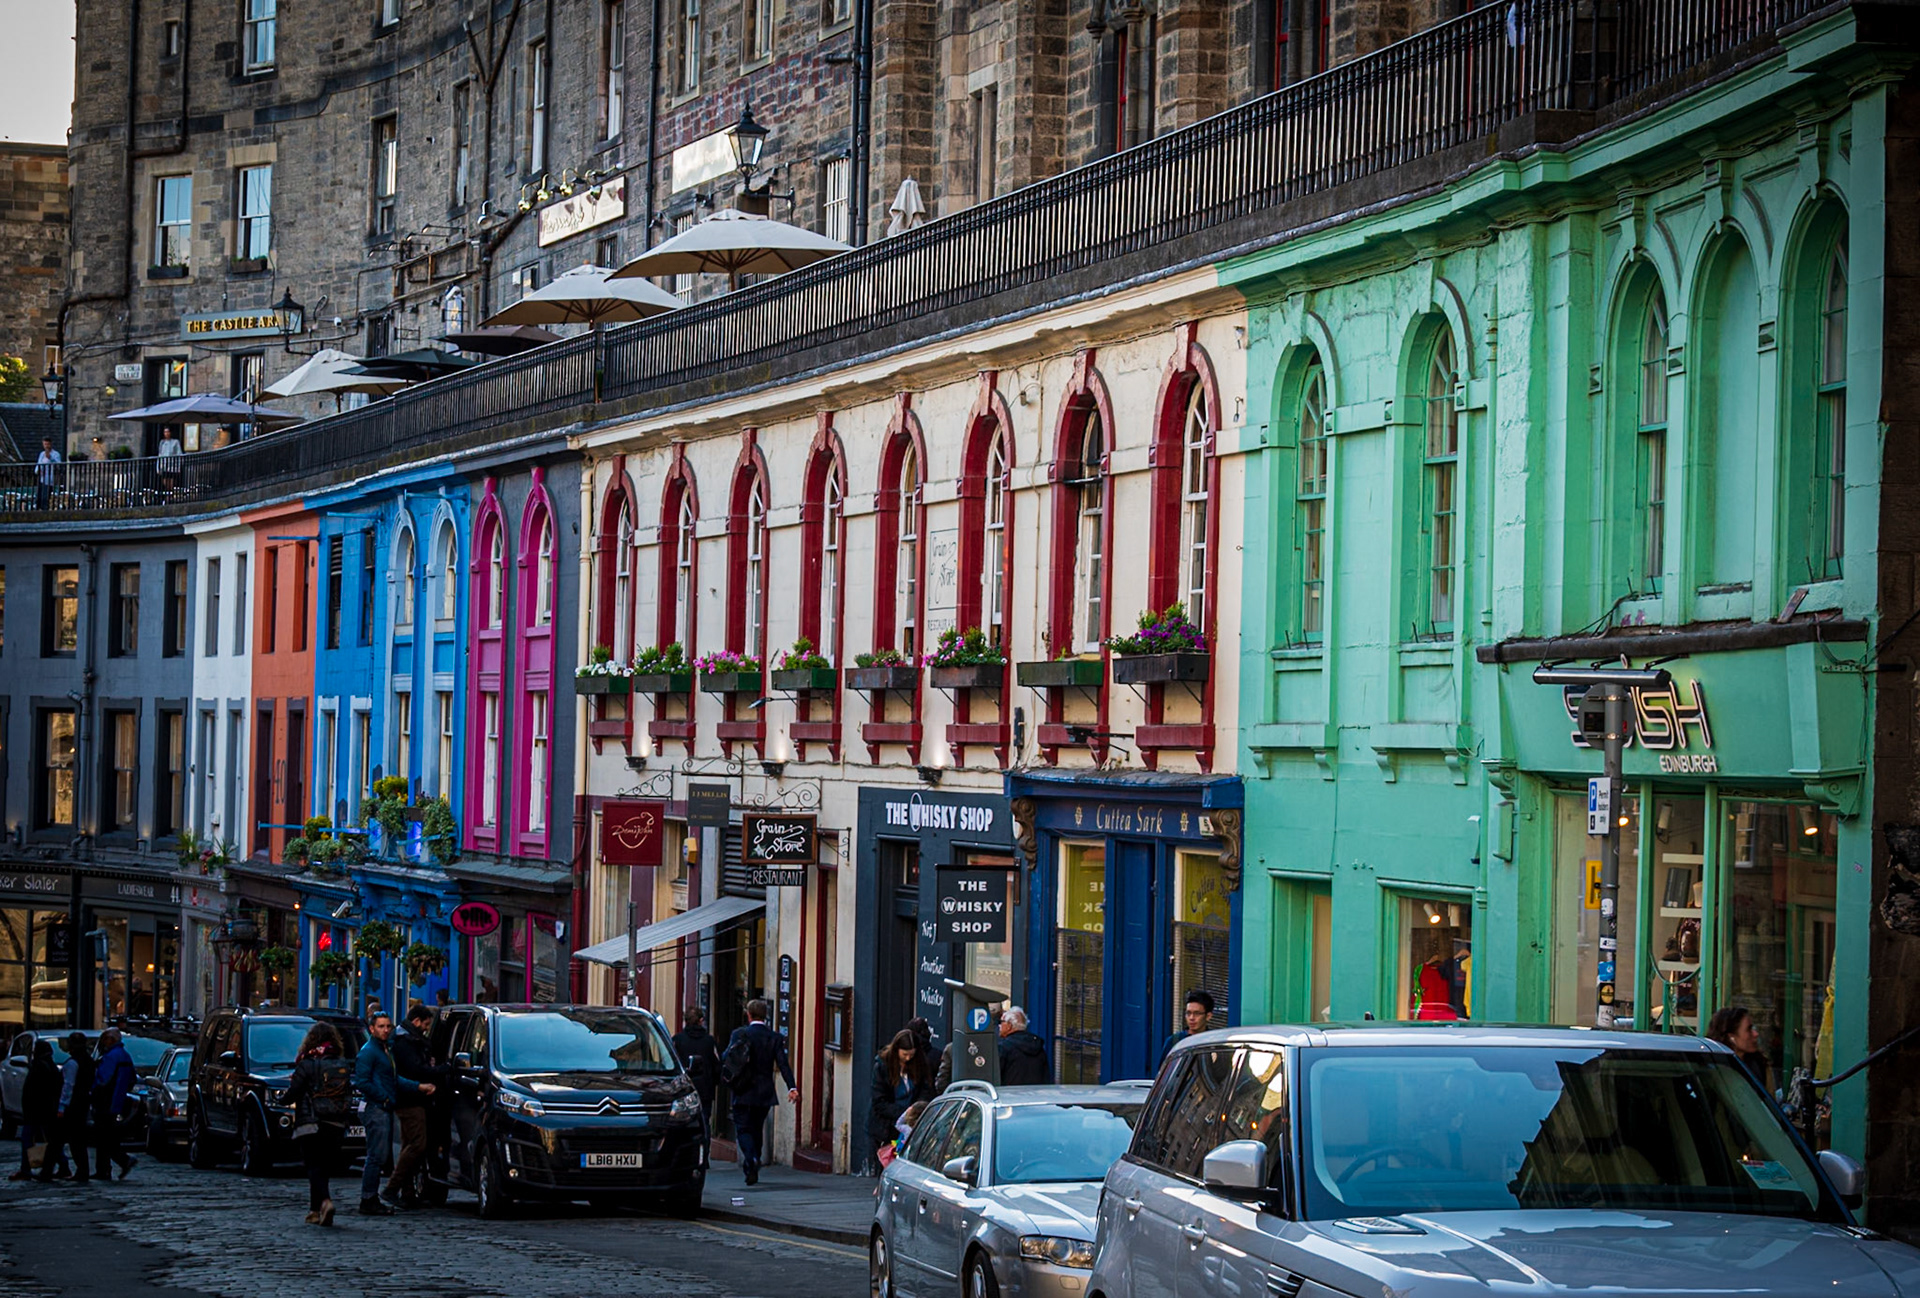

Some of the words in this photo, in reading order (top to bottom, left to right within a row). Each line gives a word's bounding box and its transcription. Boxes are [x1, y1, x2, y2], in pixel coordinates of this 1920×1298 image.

[187, 320, 208, 333] THE
[213, 317, 253, 332] CASTLE
[1659, 755, 1718, 773] EDINBURGH
[886, 802, 909, 826] THE
[910, 802, 958, 831] WHISKY
[960, 806, 994, 832] SHOP
[1096, 804, 1132, 831] Cuttea
[1136, 806, 1163, 834] Sark
[753, 819, 788, 844] Grain
[765, 837, 806, 860] Store
[24, 874, 59, 891] Slater
[752, 870, 805, 886] RESTAURANT
[958, 881, 988, 892] THE
[117, 883, 155, 898] LADIESWEAR
[942, 898, 1003, 914] WHISKY
[952, 922, 993, 933] SHOP
[921, 955, 946, 976] Another
[921, 986, 945, 1018] Whisky
[588, 1154, 613, 1166] LB18
[615, 1154, 638, 1166] HXU
